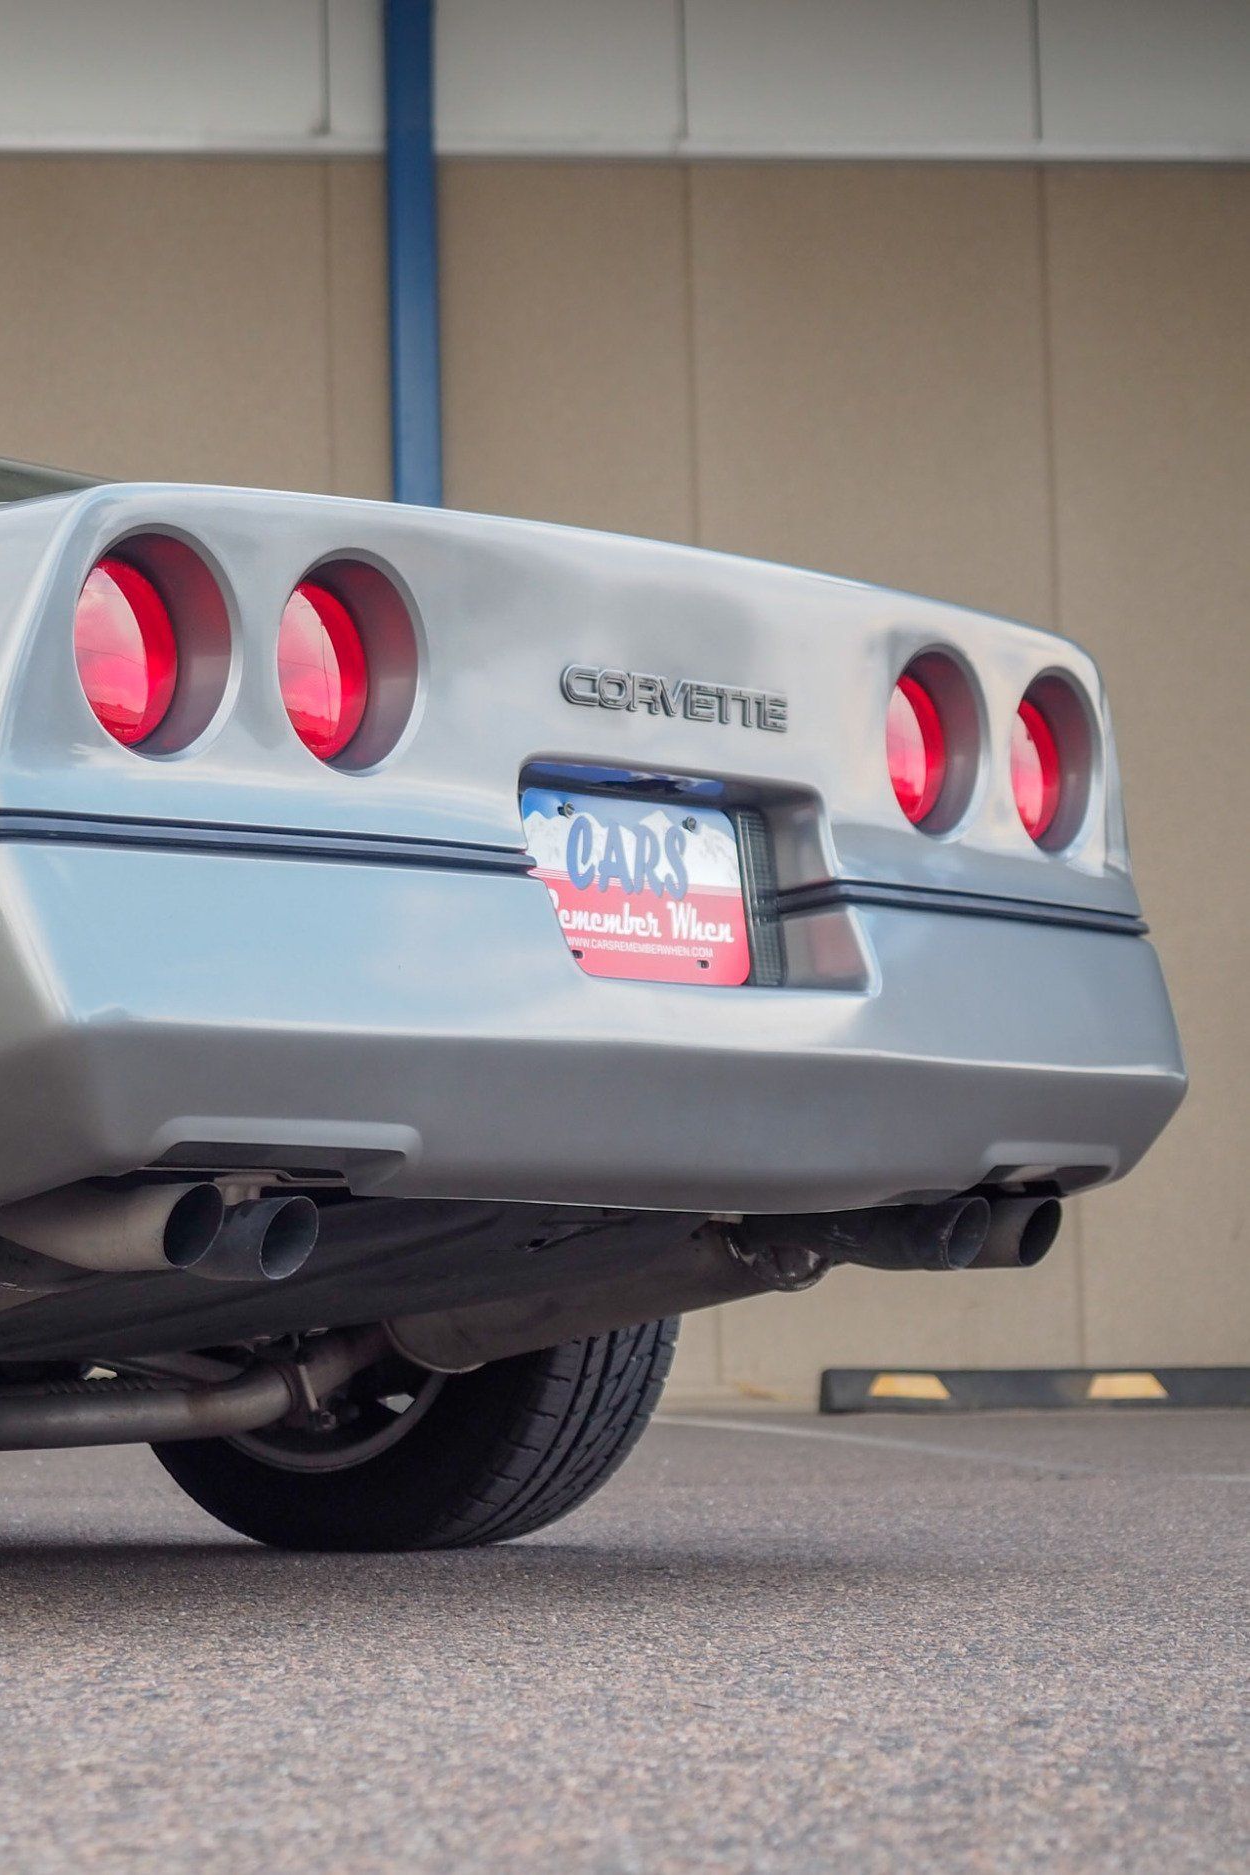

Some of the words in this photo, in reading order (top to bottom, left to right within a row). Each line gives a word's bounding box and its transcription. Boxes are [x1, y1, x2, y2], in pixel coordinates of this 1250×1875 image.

[560, 664, 788, 733] CORVETTE
[566, 816, 688, 901] CARS
[666, 901, 735, 943] When
